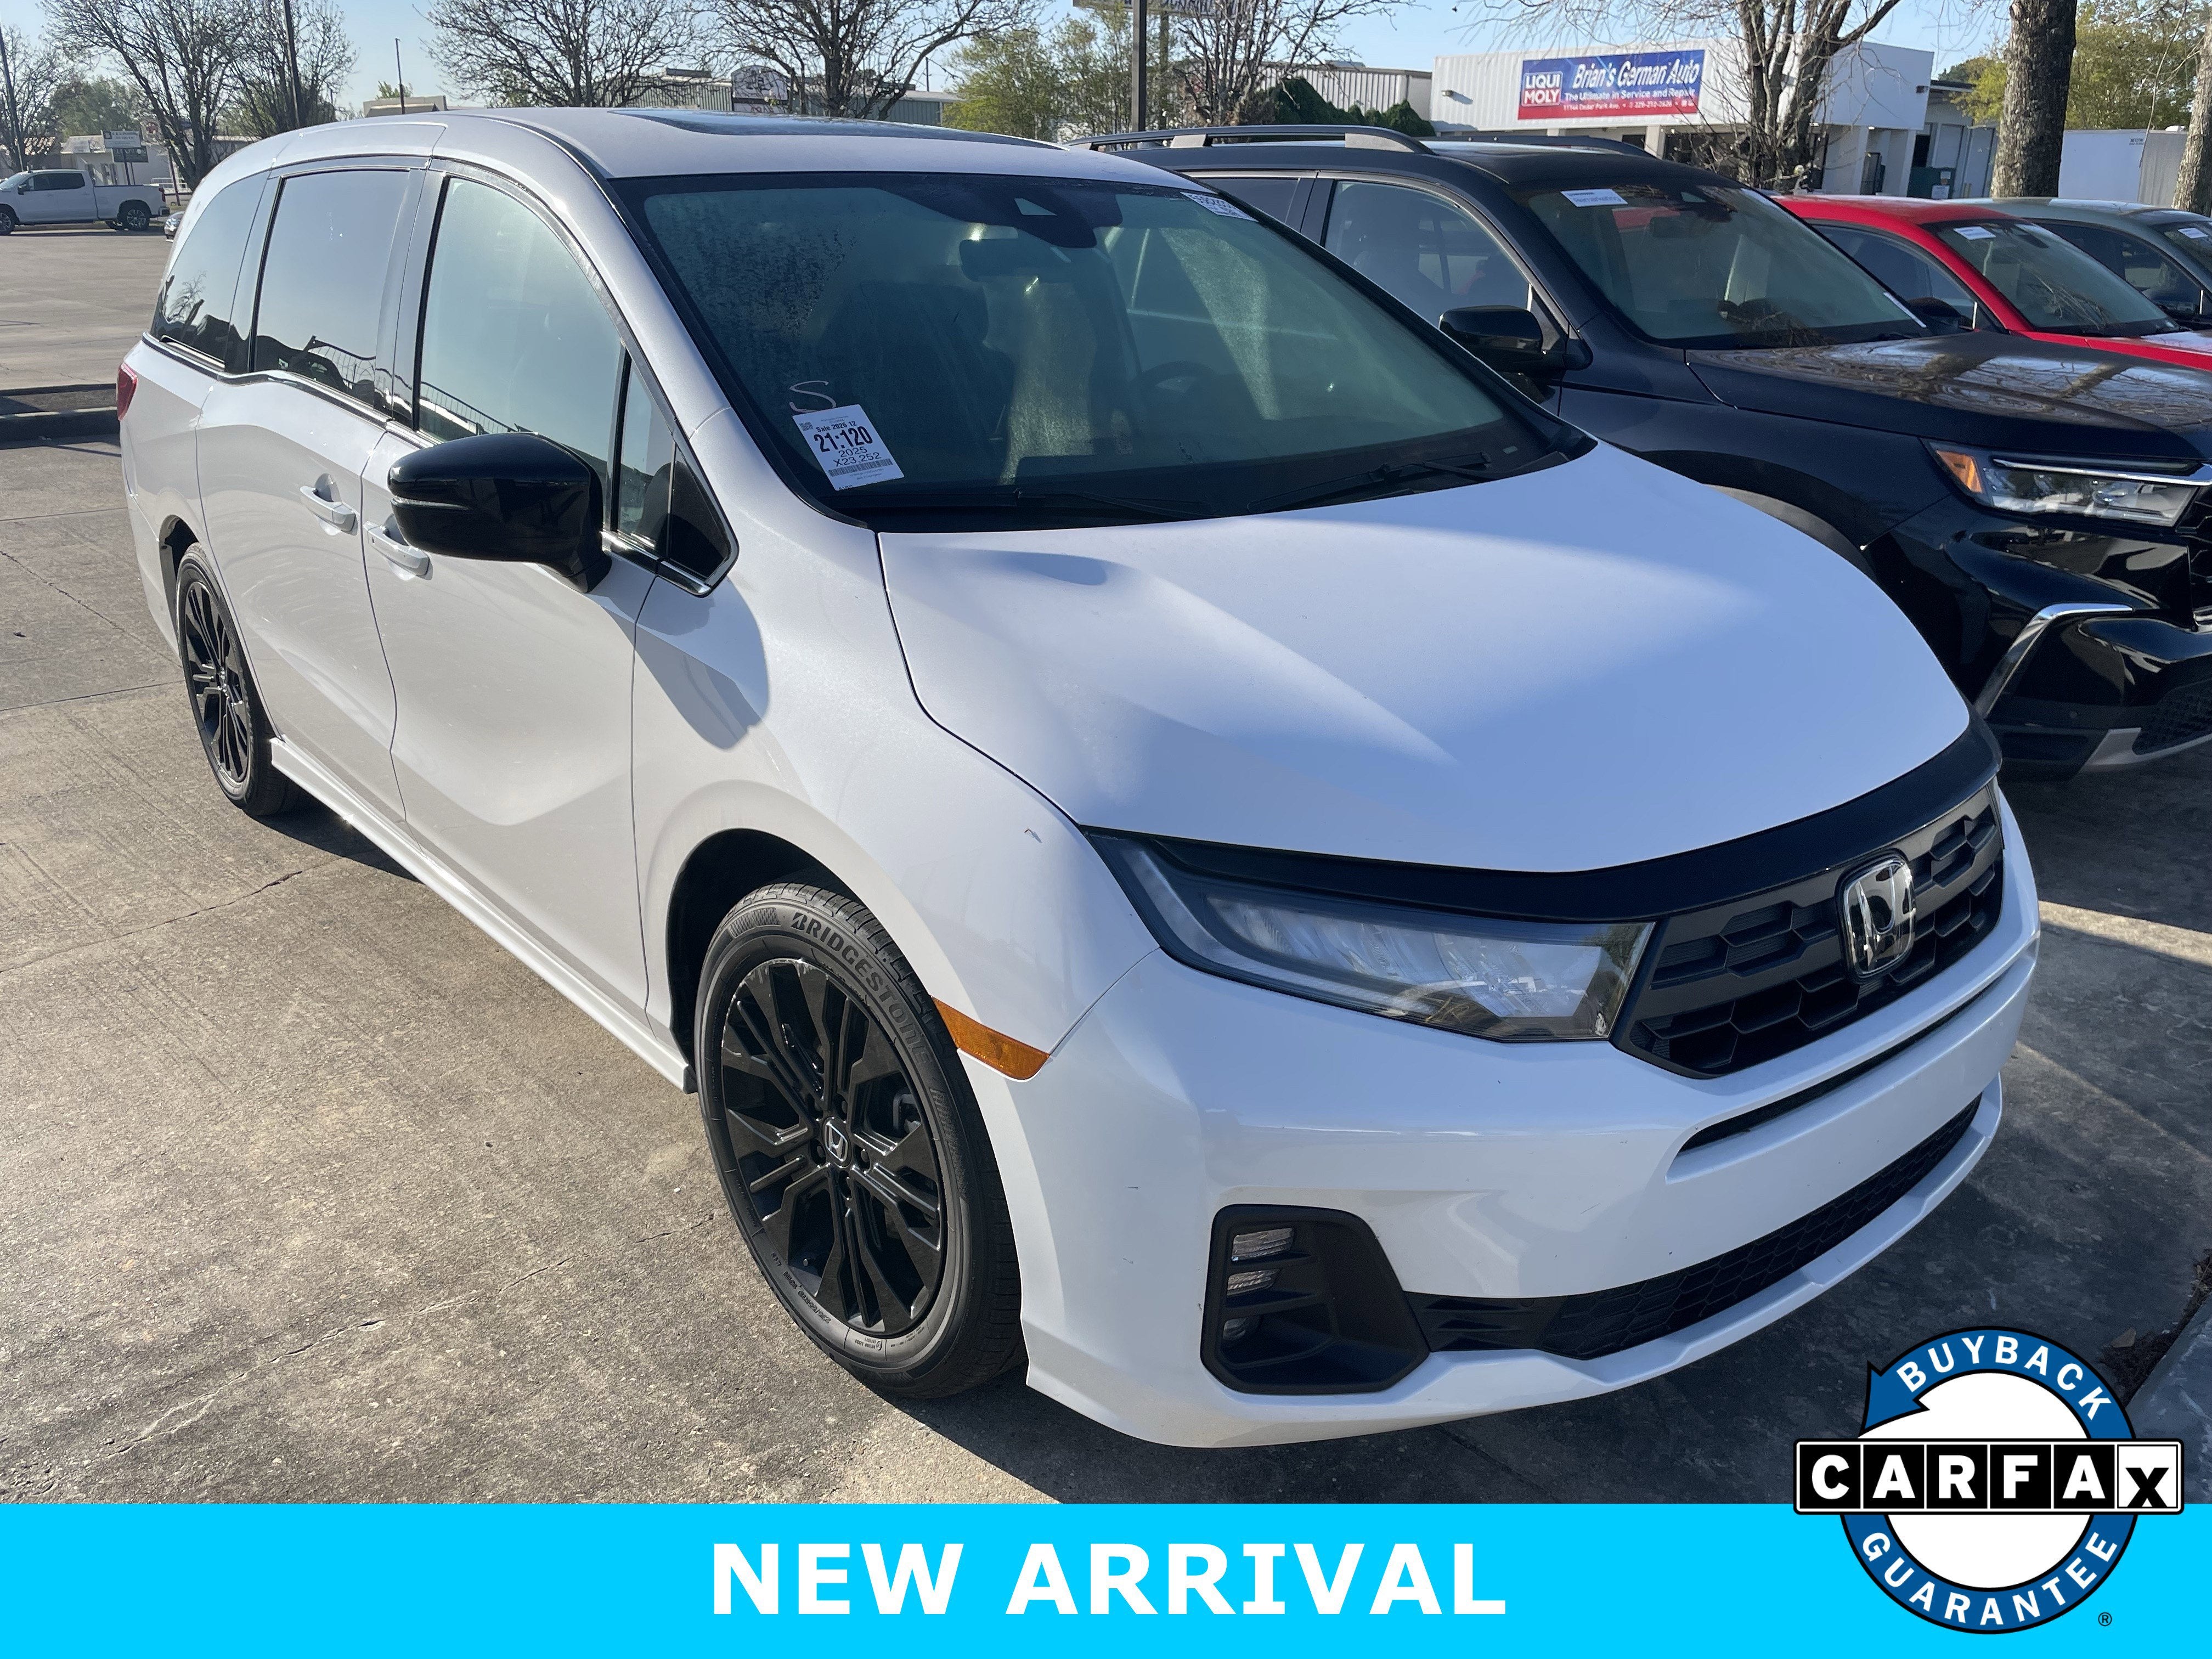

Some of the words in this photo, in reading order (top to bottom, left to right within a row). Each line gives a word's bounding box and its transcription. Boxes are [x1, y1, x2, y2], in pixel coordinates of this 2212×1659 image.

[1525, 74, 1560, 88] LIQUI
[1573, 63, 1617, 89] Brian's
[1618, 60, 1667, 87] German
[1668, 59, 1700, 84] Auto
[1524, 89, 1560, 104] MOLY
[1565, 92, 1578, 101] The
[1621, 90, 1650, 99] Service
[1652, 89, 1668, 98] and
[814, 426, 873, 452] 21:120
[833, 452, 882, 467] X23,252
[839, 447, 867, 458] 2025
[791, 912, 933, 1063] BRIDGESTONE
